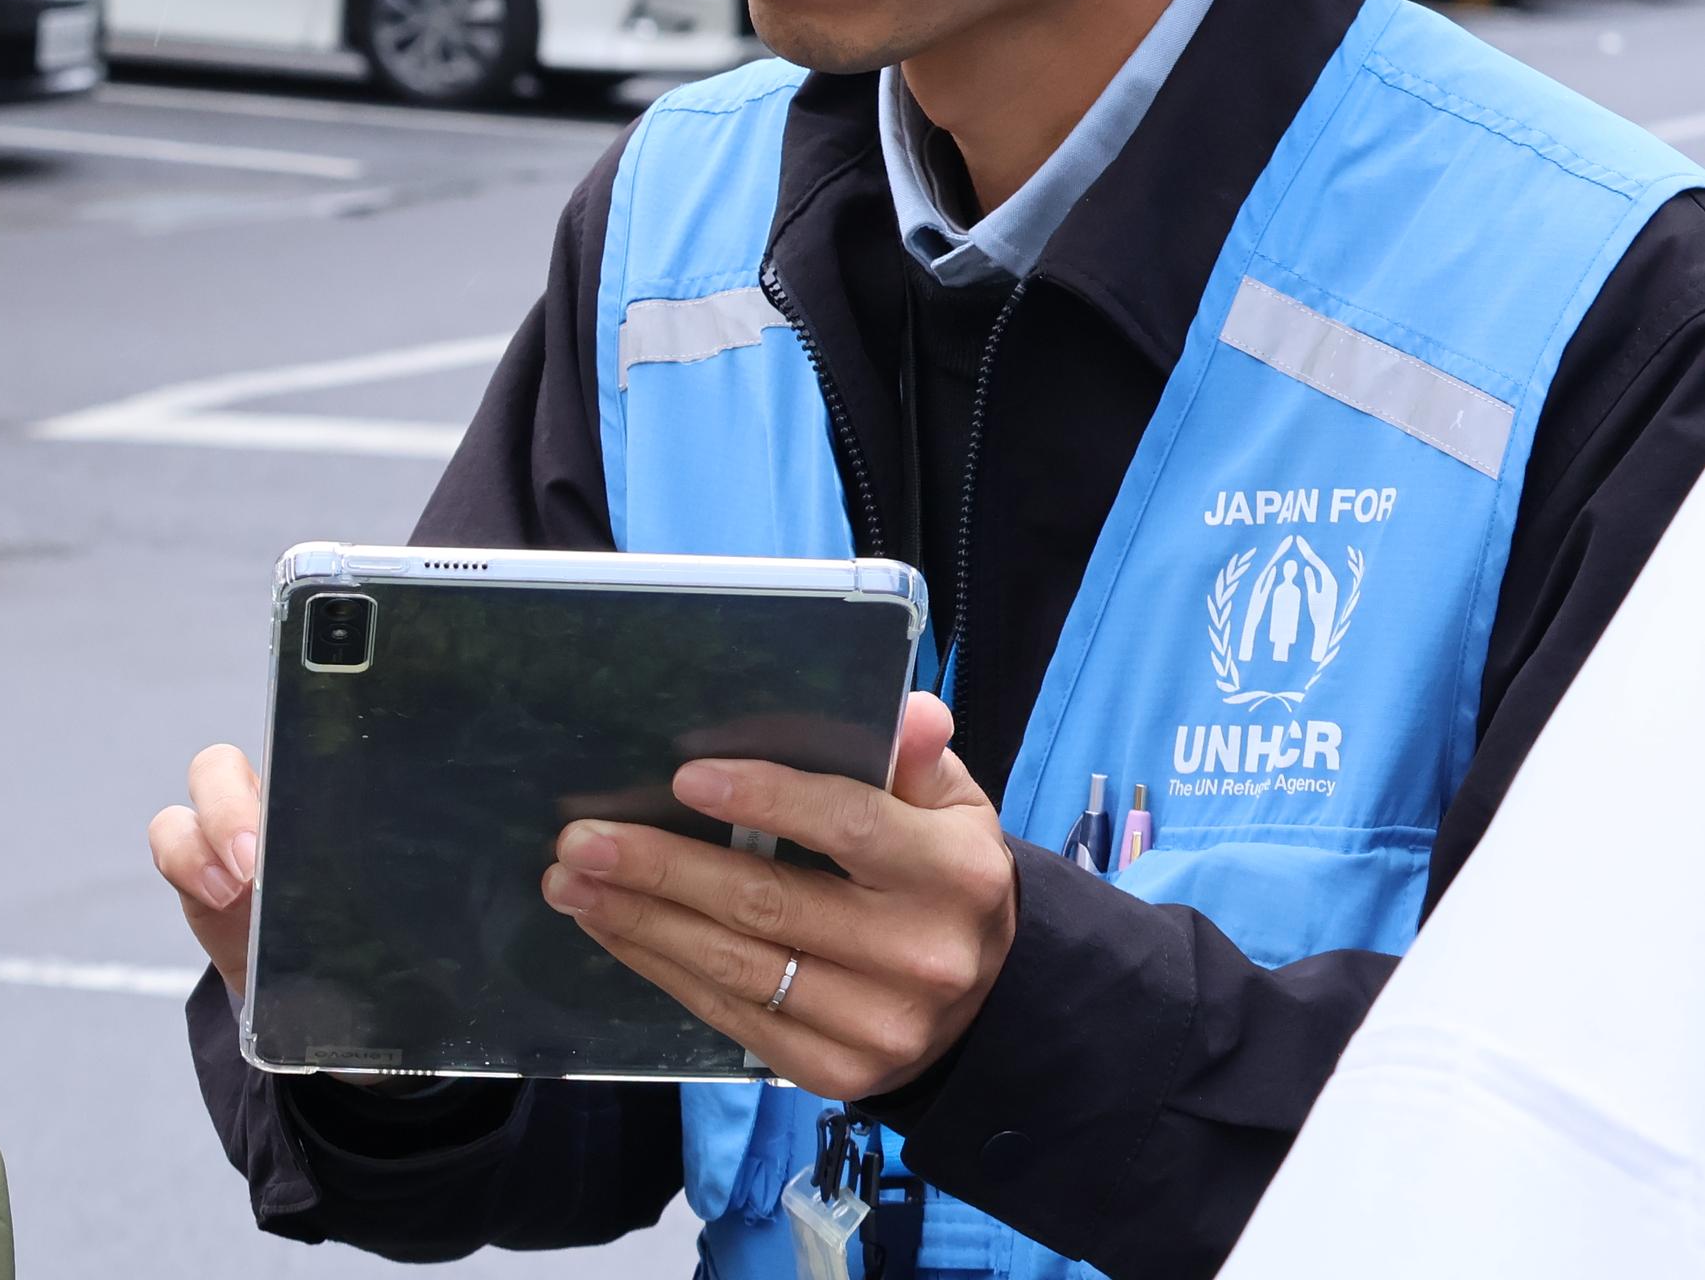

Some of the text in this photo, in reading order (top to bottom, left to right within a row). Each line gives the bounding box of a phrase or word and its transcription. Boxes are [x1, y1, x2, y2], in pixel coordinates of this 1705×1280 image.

[1204, 487, 1397, 526] JAPAN FOR
[1173, 720, 1342, 774] UNHCR
[1169, 779, 1192, 796] The
[1195, 779, 1217, 795] UN
[1274, 775, 1335, 797] Agency
